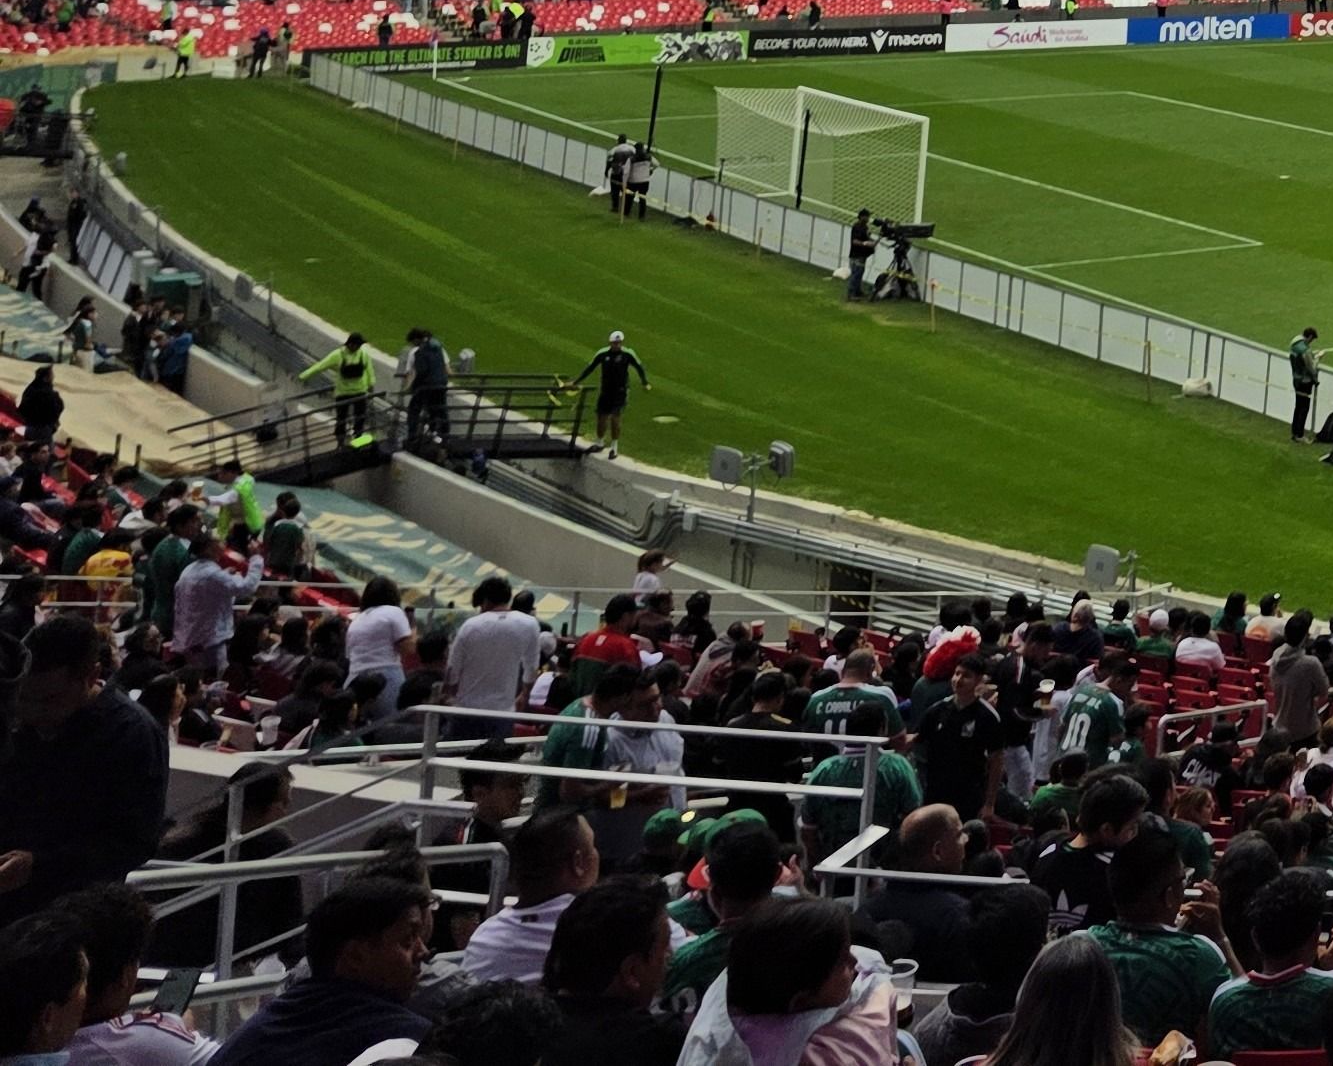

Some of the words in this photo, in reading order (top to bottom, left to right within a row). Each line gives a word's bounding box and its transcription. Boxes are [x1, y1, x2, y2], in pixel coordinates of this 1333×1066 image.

[1160, 16, 1255, 42] molten
[754, 37, 792, 51] BECOME
[793, 36, 815, 50] YOUR
[818, 36, 839, 49] OWN
[888, 32, 943, 47] macron
[369, 50, 388, 64] FOR
[389, 49, 406, 64] THE
[455, 46, 491, 61] STRIKER
[493, 46, 501, 58] IS
[504, 45, 521, 57] ON!
[1061, 713, 1091, 750] 10
